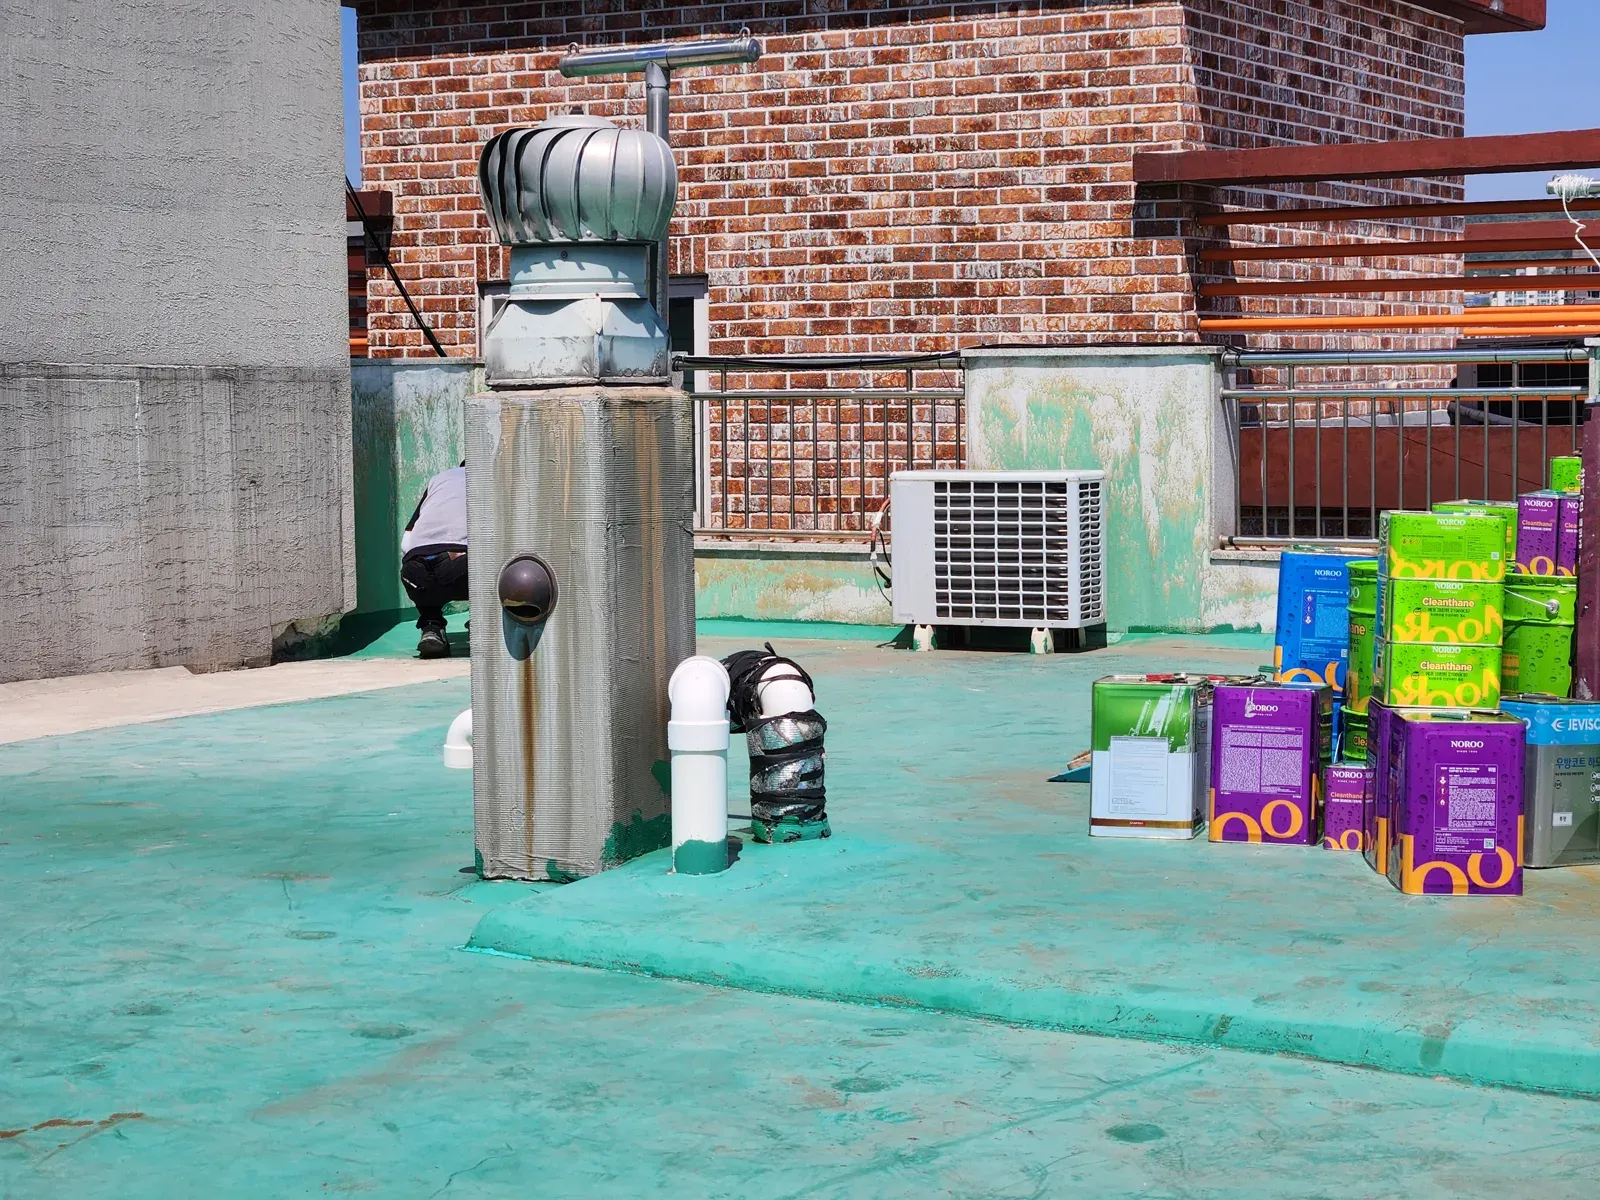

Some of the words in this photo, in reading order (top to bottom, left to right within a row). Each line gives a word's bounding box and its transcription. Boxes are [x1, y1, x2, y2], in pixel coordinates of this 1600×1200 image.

[1524, 499, 1554, 508] NOROO
[1436, 518, 1467, 526] NOROO
[1521, 519, 1553, 527] Cleanthane
[1314, 569, 1342, 577] NOROO
[1434, 582, 1464, 590] NOROO
[1422, 597, 1475, 608] Cleanthane
[1432, 645, 1461, 654] NOROO
[1420, 661, 1473, 672] Cleanthane
[1450, 740, 1484, 748] NOROO
[1556, 757, 1586, 769] 우방코트
[1332, 770, 1363, 779] NOROO
[1330, 791, 1364, 799] Cleanthane
